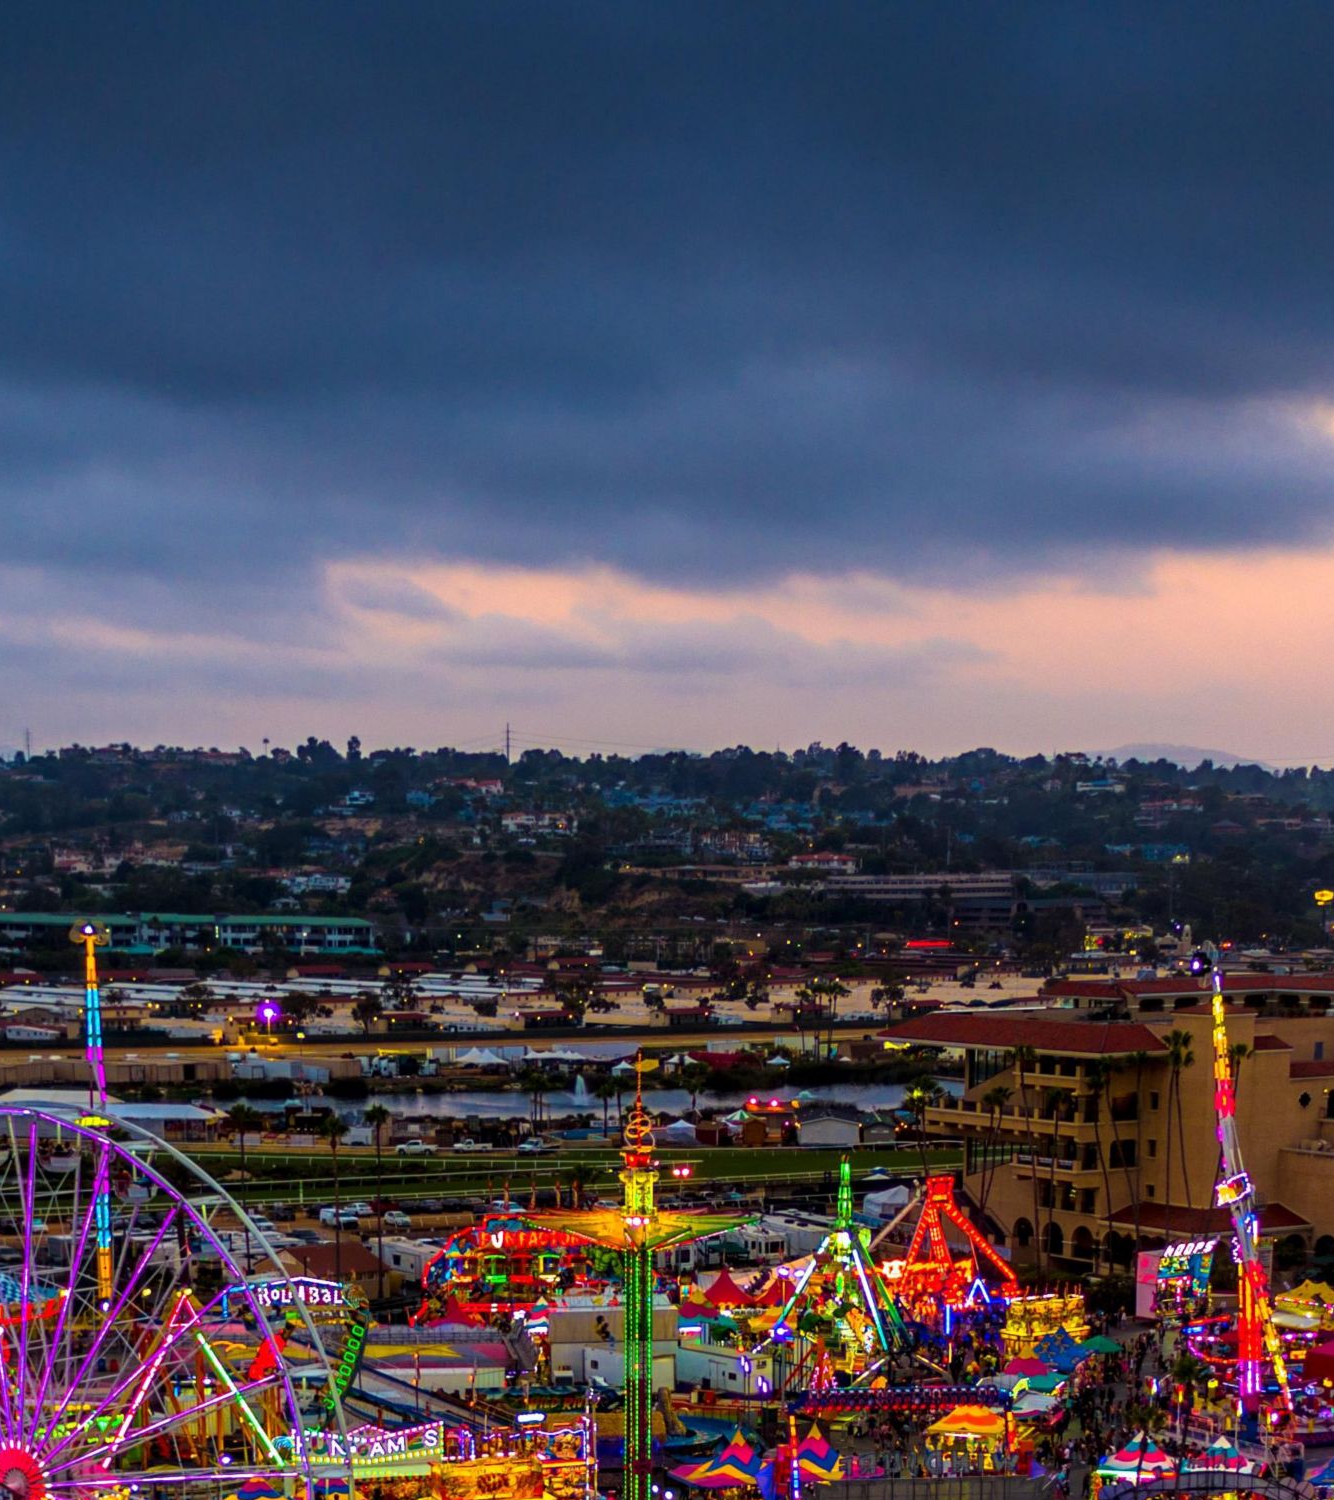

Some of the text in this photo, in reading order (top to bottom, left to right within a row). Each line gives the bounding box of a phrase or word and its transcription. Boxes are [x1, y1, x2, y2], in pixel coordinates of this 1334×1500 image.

[480, 1231, 515, 1249] FUN
[1163, 1240, 1217, 1258] HOOPS
[295, 1434, 348, 1457] FUN
